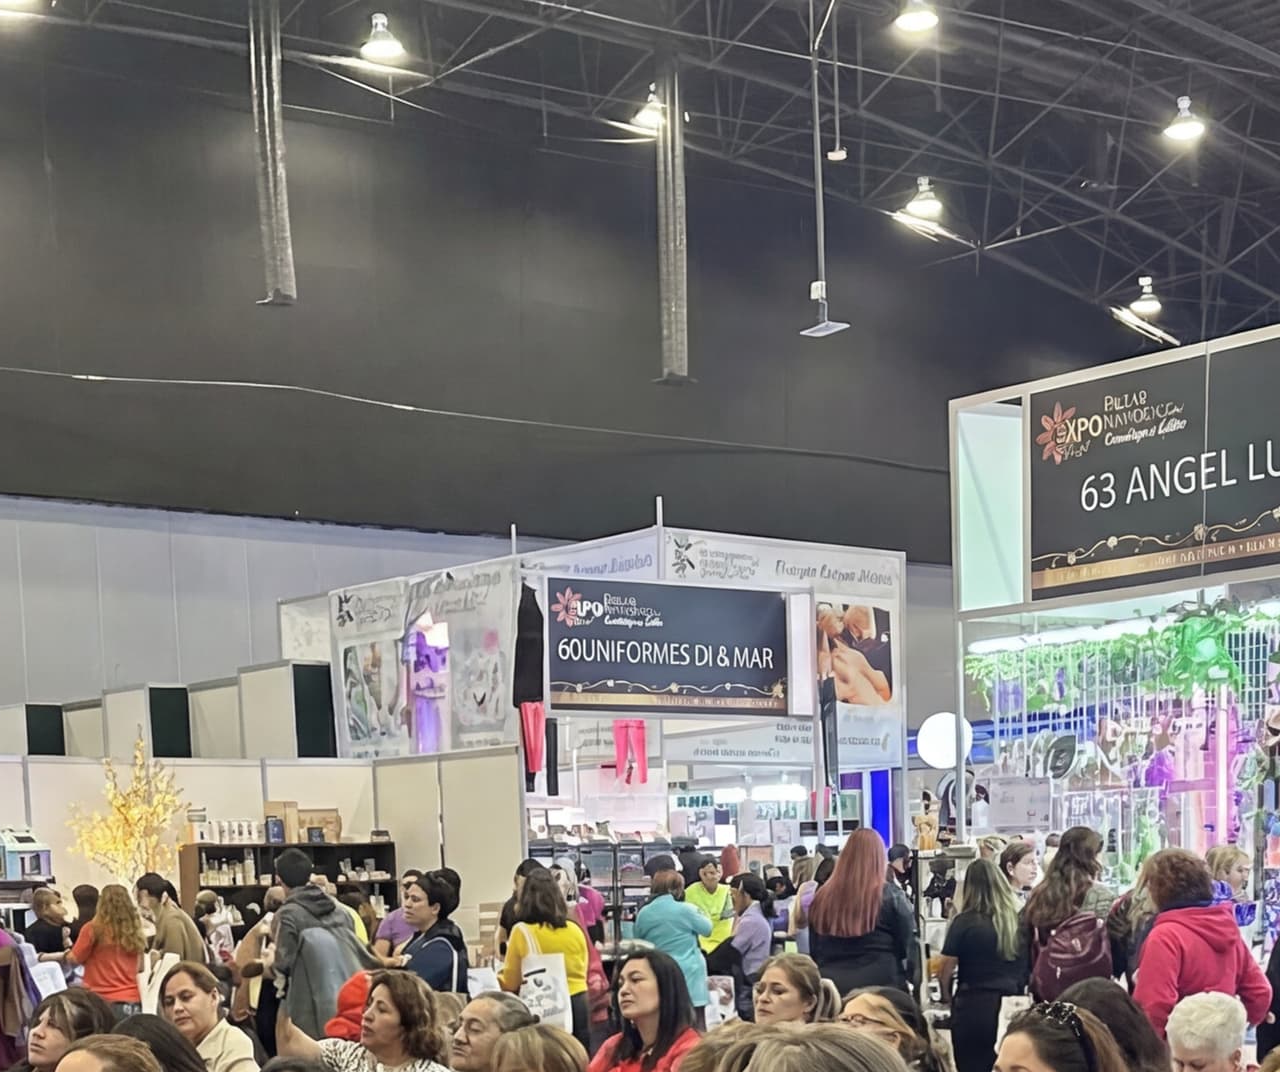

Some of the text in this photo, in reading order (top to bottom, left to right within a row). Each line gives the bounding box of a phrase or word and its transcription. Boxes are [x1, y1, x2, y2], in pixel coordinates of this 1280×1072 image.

[1080, 471, 1117, 512] 63
[1125, 449, 1238, 504] ANGEL
[558, 638, 774, 670] 60UNIFORMES DI & MAR
